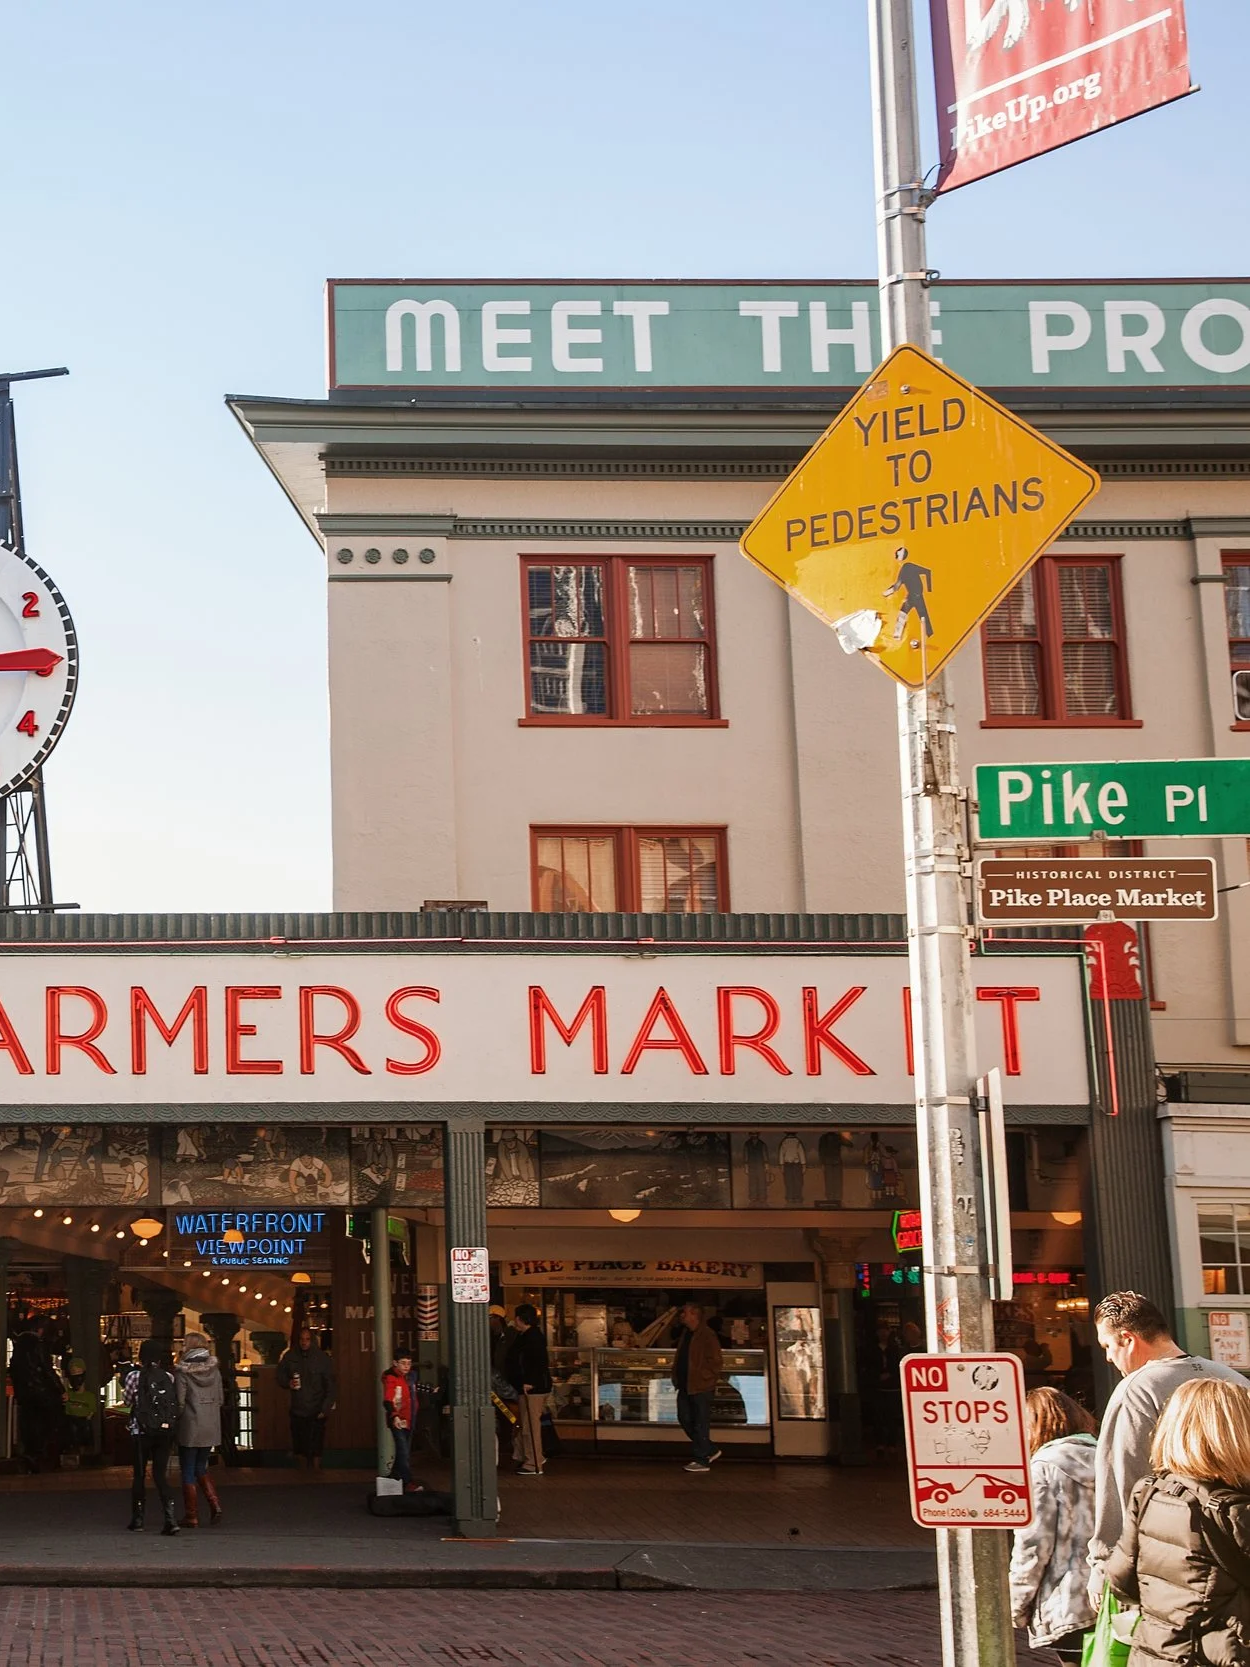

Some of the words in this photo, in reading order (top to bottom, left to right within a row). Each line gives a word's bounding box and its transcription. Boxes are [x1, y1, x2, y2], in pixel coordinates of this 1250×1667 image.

[385, 299, 669, 373] MEET
[739, 300, 943, 373] TH
[1028, 298, 1250, 374] PRO
[854, 398, 966, 447] YIELD
[886, 450, 932, 487] TO
[786, 477, 1045, 552] PEDESTRIANS
[22, 592, 40, 618] 2
[16, 710, 39, 737] 4
[998, 770, 1128, 826] Pike
[1165, 785, 1208, 823] Pl
[1016, 870, 1102, 879] HISTORICAL
[1108, 870, 1177, 879] DISTRICT
[989, 888, 1042, 907] Pike
[1046, 888, 1111, 907] Place
[1116, 888, 1207, 908] Market
[528, 985, 1040, 1077] MARKT
[176, 1213, 326, 1234] WATERFRONT
[196, 1239, 306, 1255] VIEWPOINT
[455, 1250, 469, 1260] NO
[220, 1257, 250, 1265] PUBLIC
[252, 1257, 289, 1265] SEATING
[456, 1263, 484, 1272] STOPS
[509, 1260, 564, 1276] PIKE
[573, 1260, 646, 1271] PLACE
[656, 1260, 753, 1279] BAKERY
[1220, 1341, 1241, 1349] ANY
[911, 1366, 943, 1387] NO
[922, 1400, 1009, 1424] STOPS
[923, 1508, 946, 1517] Phone
[983, 1508, 1026, 1518] 684-5444
